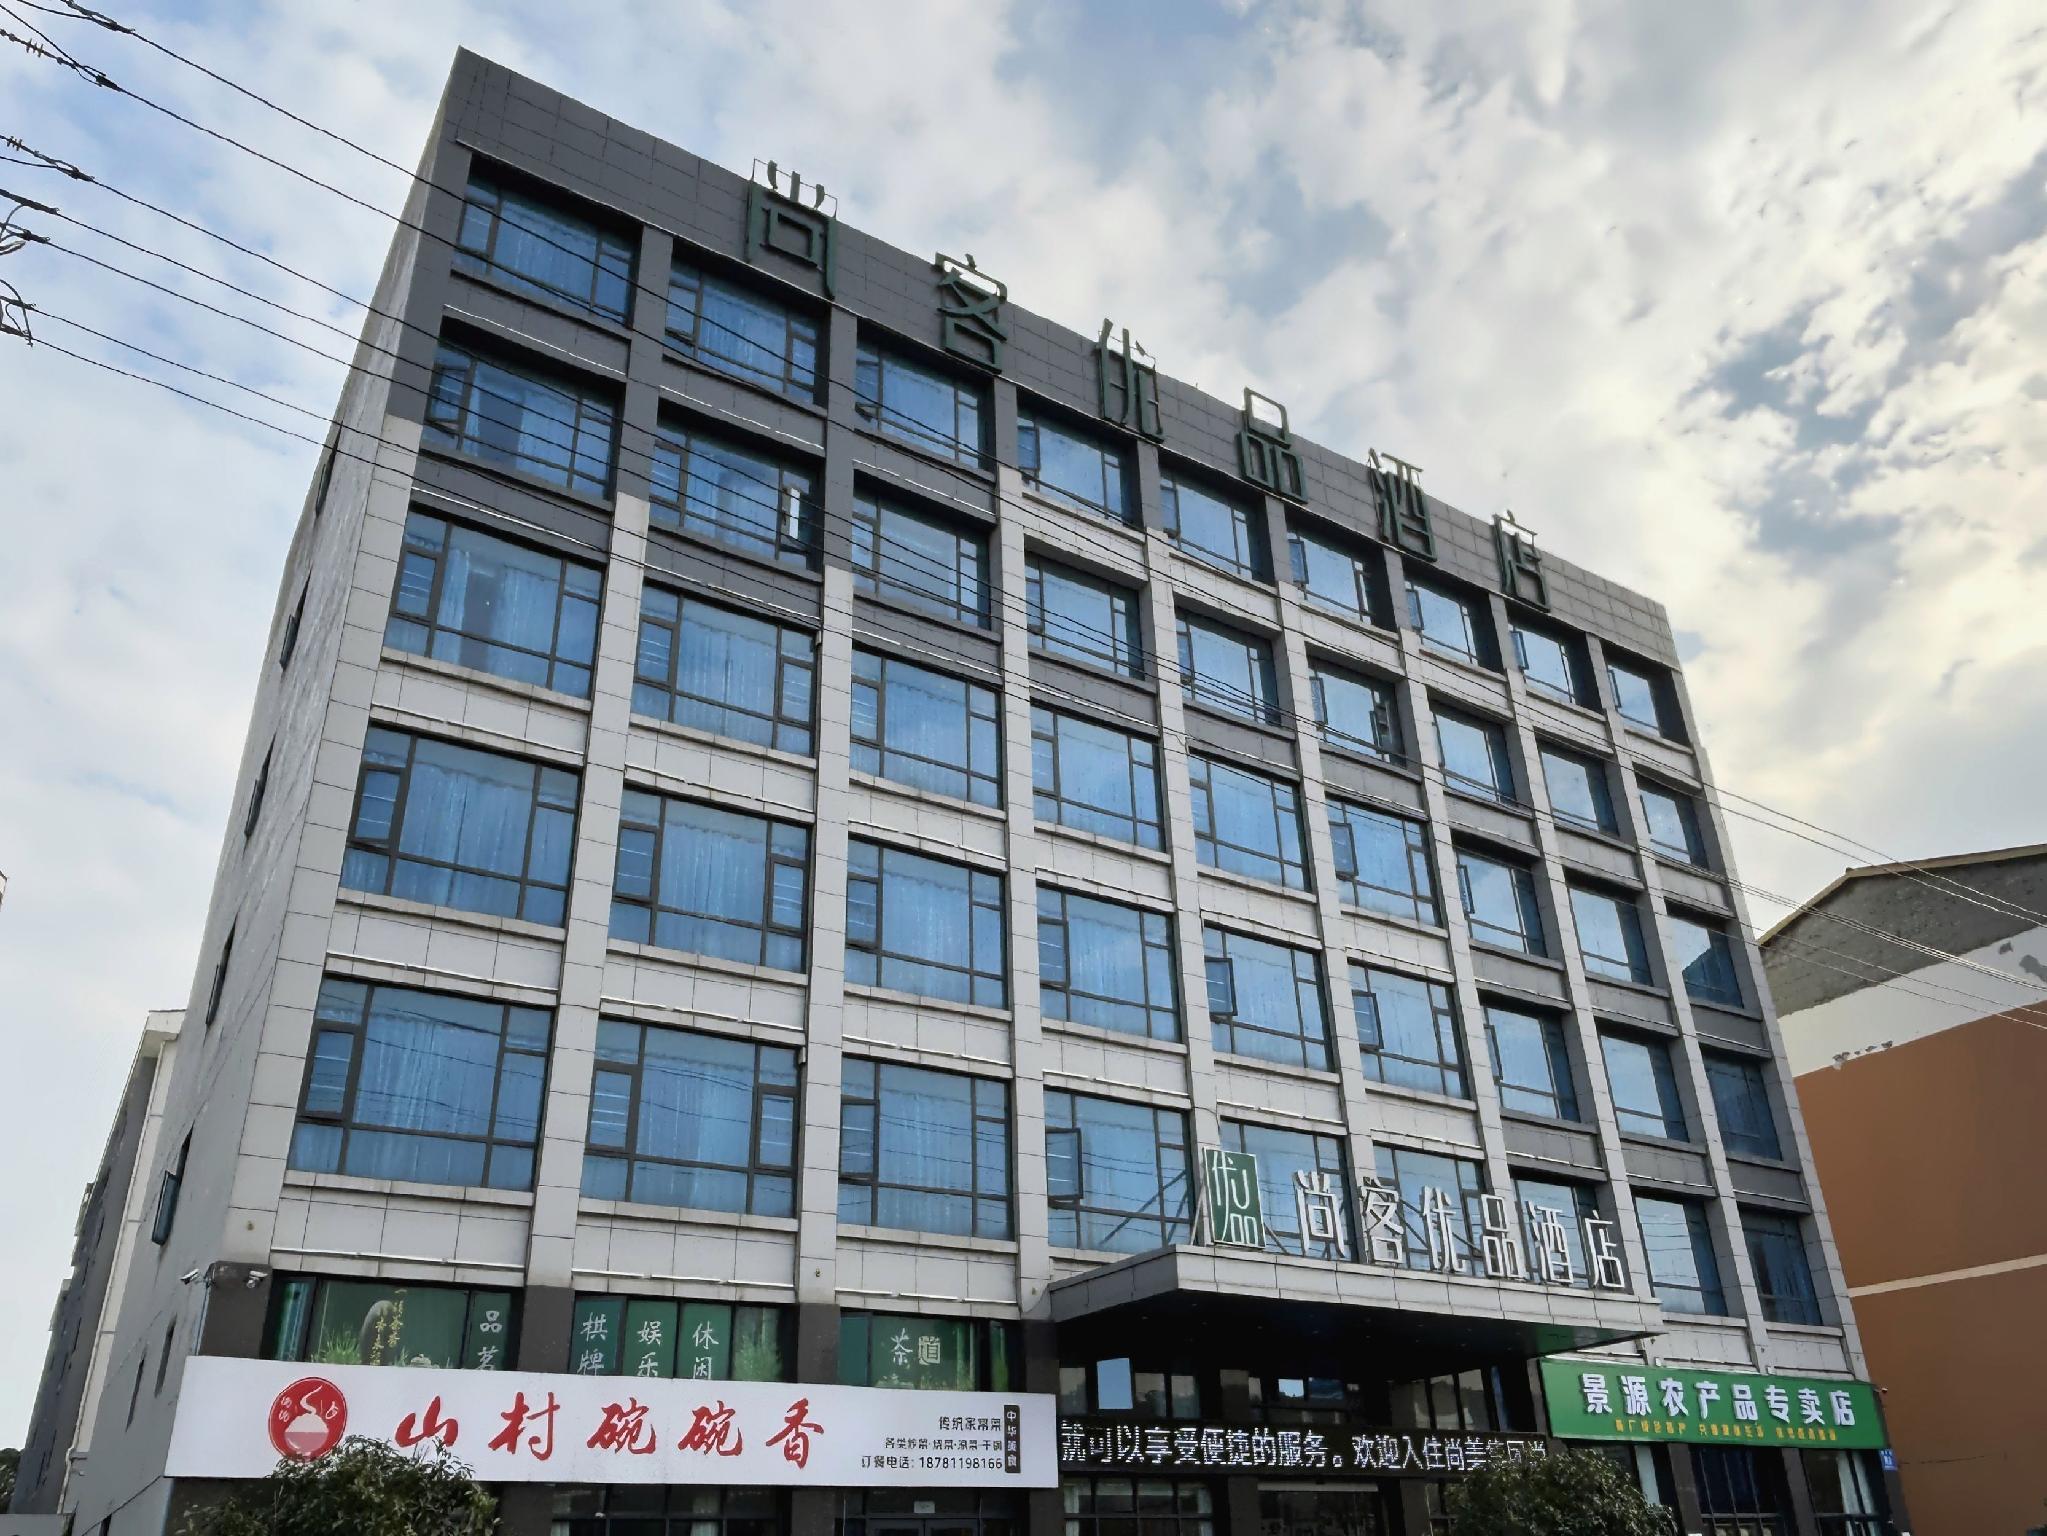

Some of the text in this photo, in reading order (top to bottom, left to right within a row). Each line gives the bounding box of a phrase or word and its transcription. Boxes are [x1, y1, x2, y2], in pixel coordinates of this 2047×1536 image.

[746, 160, 1551, 612] 尚客优品酒店
[1294, 1169, 1625, 1289] 尚客优品酒店
[577, 1312, 609, 1375] 棋牌
[637, 1320, 662, 1376] 娱乐
[692, 1320, 719, 1379] 休闲
[395, 1391, 824, 1469] 山村碗碗香
[1580, 1373, 1856, 1426] 景源农产品专卖店
[919, 1457, 1003, 1469] 18781198166
